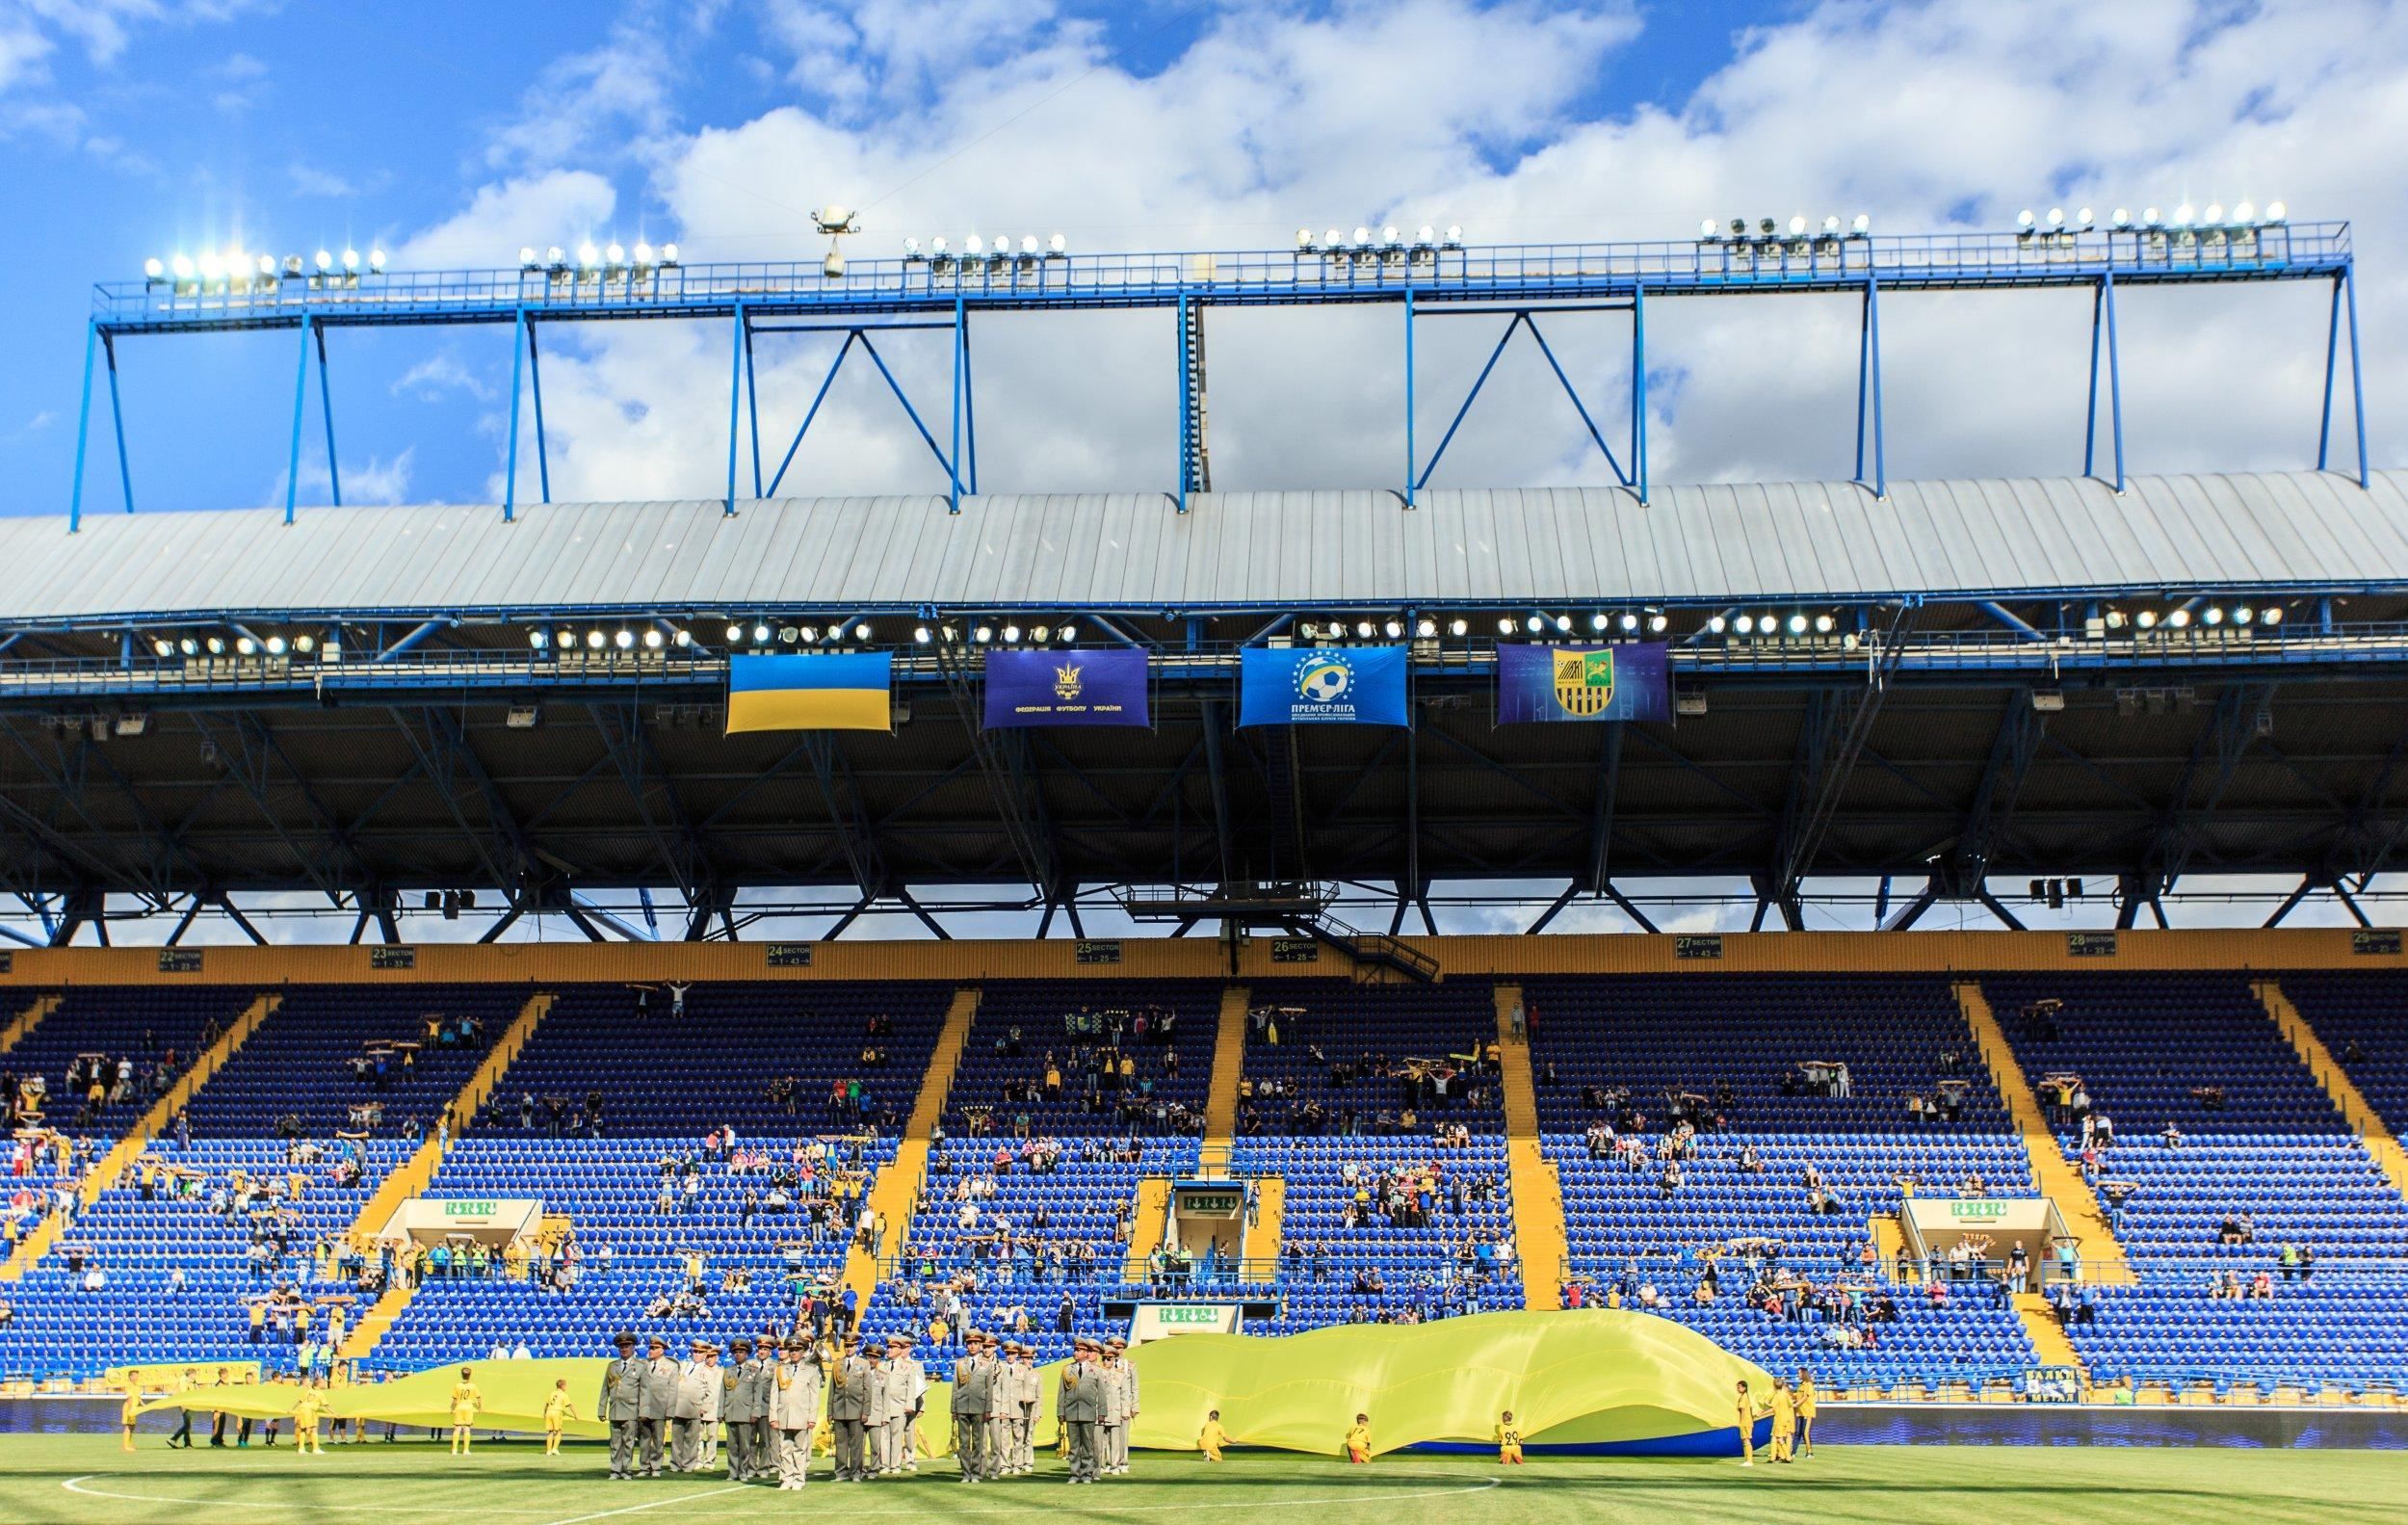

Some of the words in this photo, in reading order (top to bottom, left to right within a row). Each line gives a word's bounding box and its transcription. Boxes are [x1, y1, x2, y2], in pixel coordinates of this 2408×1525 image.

[1677, 937, 1691, 948] 27
[2070, 934, 2085, 945] 28
[2354, 933, 2369, 943] 29
[769, 945, 783, 956] 24
[1078, 943, 1091, 954] 25
[1274, 941, 1289, 952] 26
[161, 951, 174, 962] 22
[373, 948, 386, 959] 23
[459, 1389, 470, 1400] 10
